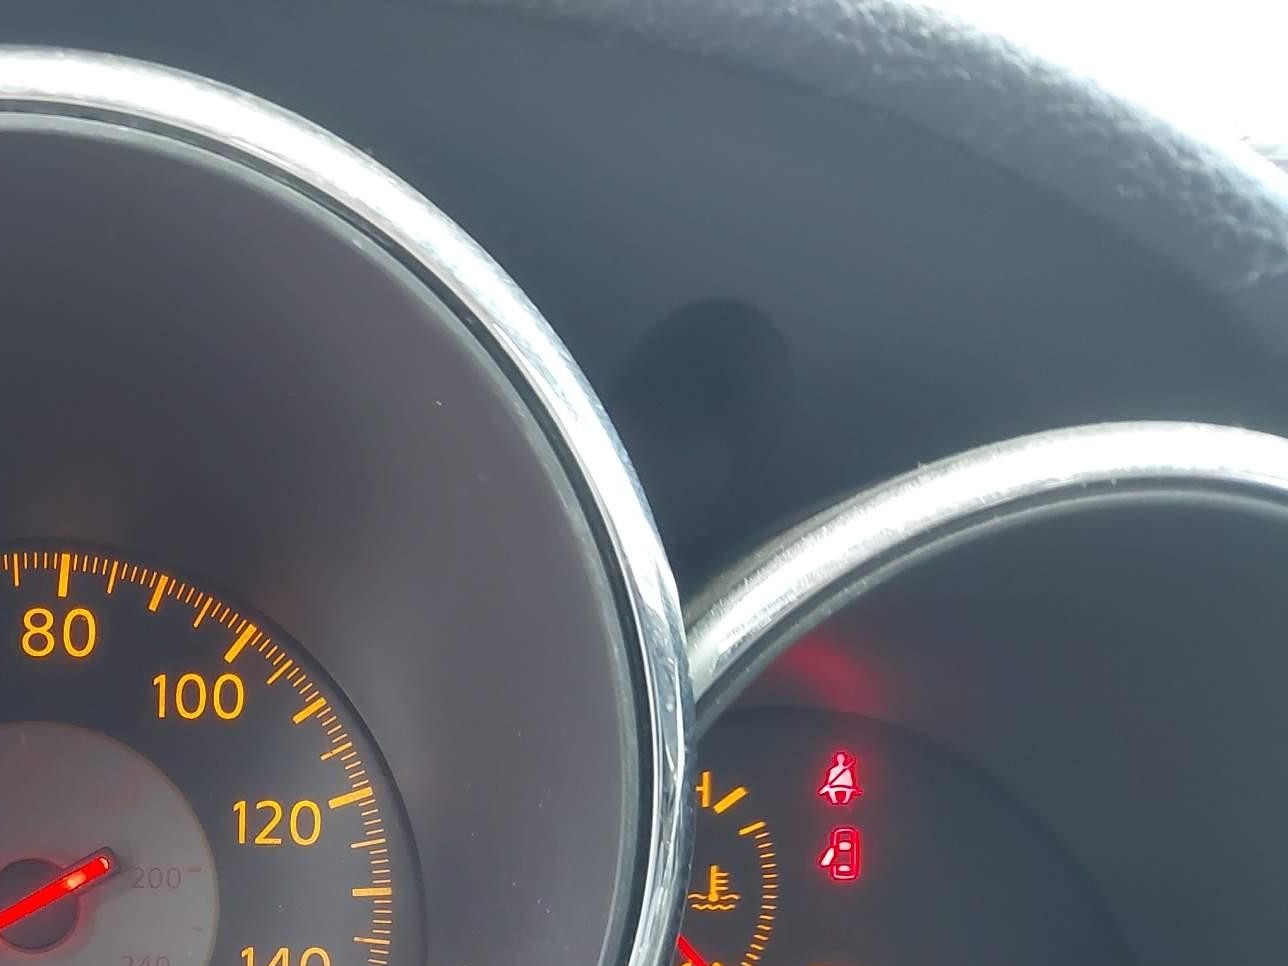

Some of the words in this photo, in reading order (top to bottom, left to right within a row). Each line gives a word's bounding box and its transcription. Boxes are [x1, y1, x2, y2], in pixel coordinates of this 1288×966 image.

[21, 608, 97, 658] 80
[152, 673, 245, 720] 100
[232, 800, 322, 847] 120
[129, 866, 182, 890] 200
